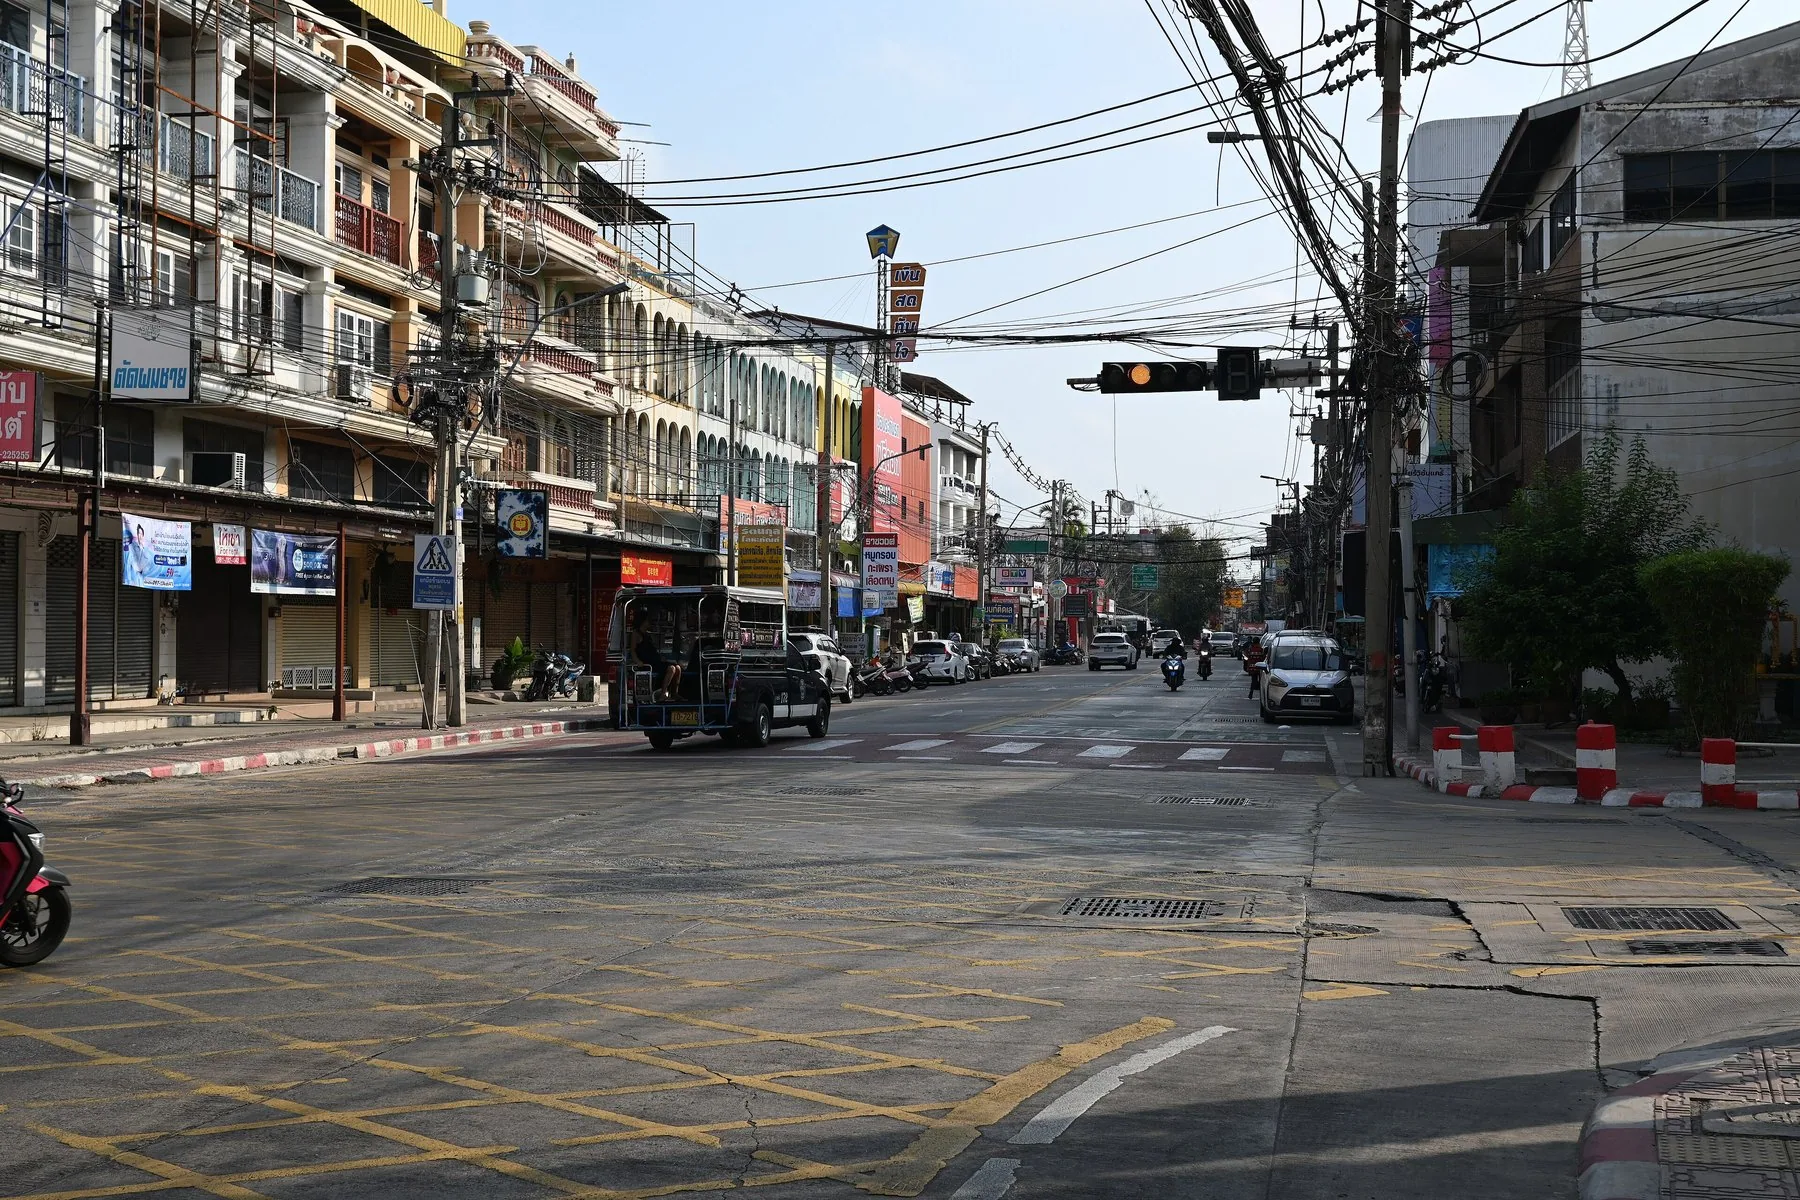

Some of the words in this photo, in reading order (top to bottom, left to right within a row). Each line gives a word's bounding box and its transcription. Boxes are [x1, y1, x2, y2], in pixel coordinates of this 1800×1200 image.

[894, 266, 920, 282] เงิน
[895, 295, 917, 307] สด
[894, 341, 909, 359] ใจ
[113, 360, 188, 389] ตัดผมชาย
[865, 551, 896, 562] หมูกรอบ
[867, 564, 893, 573] กะเพรา
[1002, 569, 1027, 577] BTV
[866, 575, 895, 588] เลือดหมู
